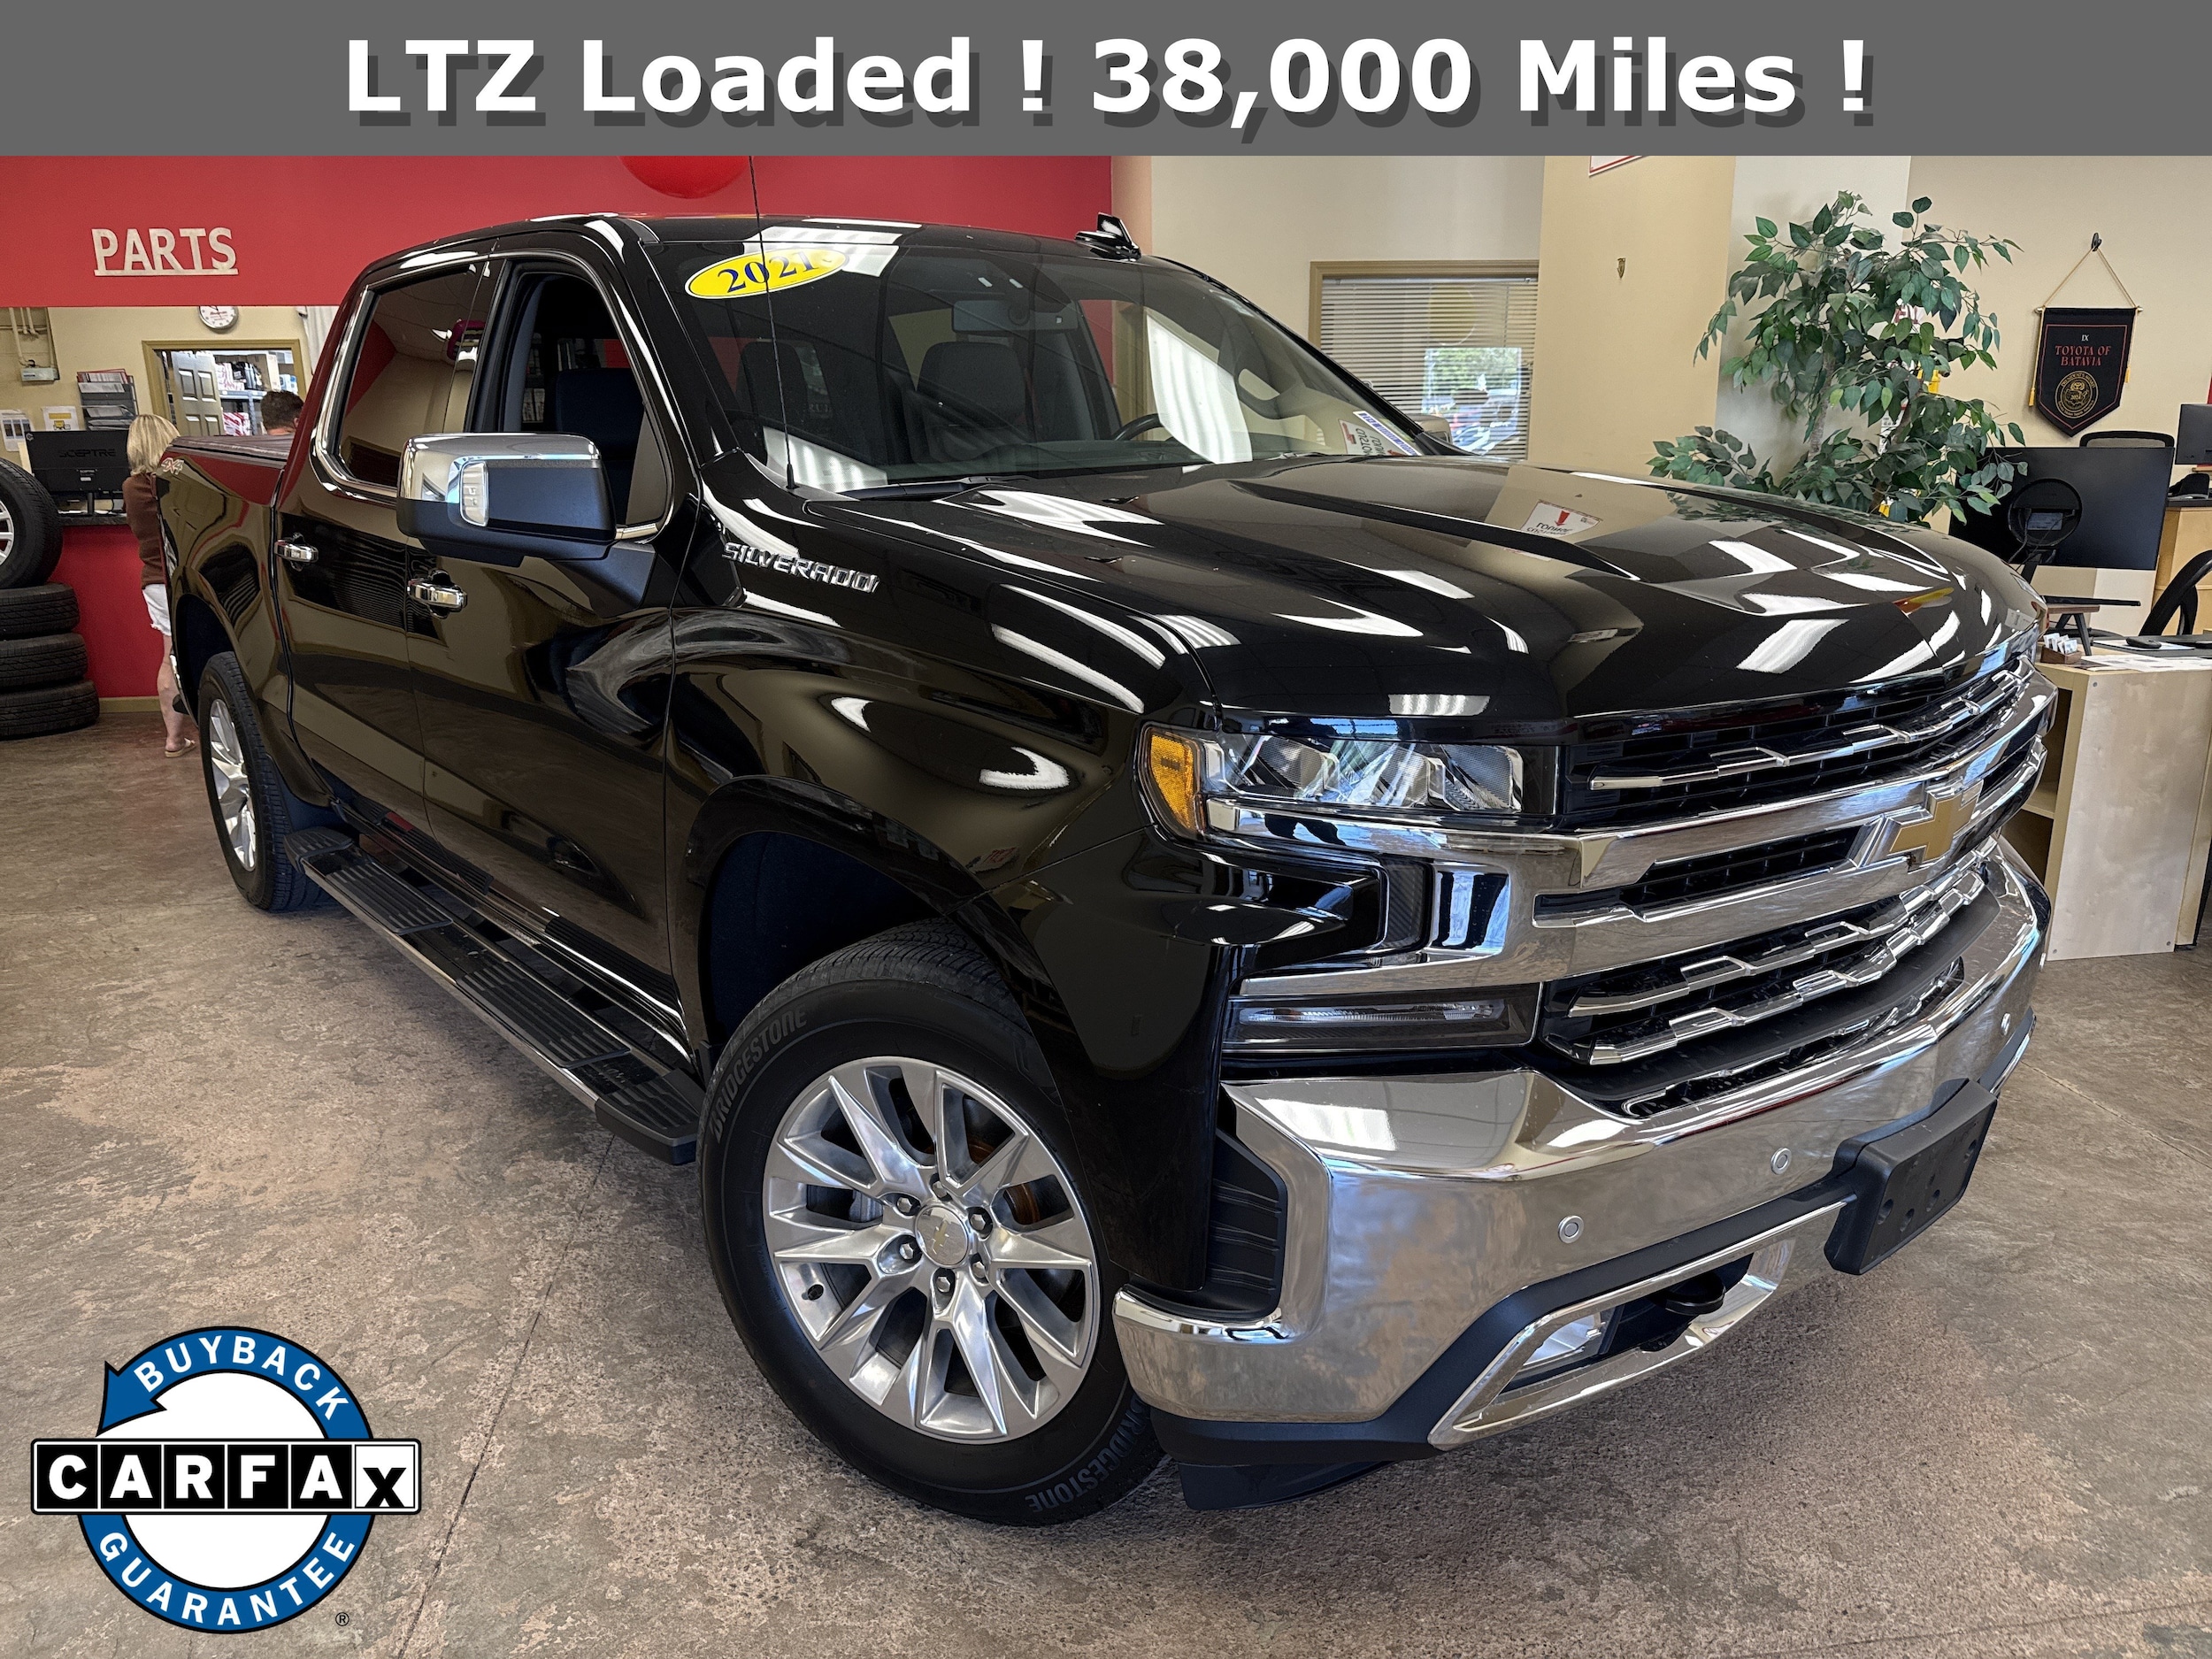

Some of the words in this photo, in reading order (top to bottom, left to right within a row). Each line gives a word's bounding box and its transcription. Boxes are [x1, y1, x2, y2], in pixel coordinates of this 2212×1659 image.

[91, 227, 237, 273] PARTS
[718, 250, 819, 293] 2021
[2055, 345, 2093, 356] TOYOTA
[2097, 345, 2112, 356] OF
[2061, 356, 2101, 366] BATAVIA
[58, 449, 117, 457] SCEPTRE
[721, 541, 881, 594] SILVERADO
[709, 1006, 807, 1144] BRIDGESTONE
